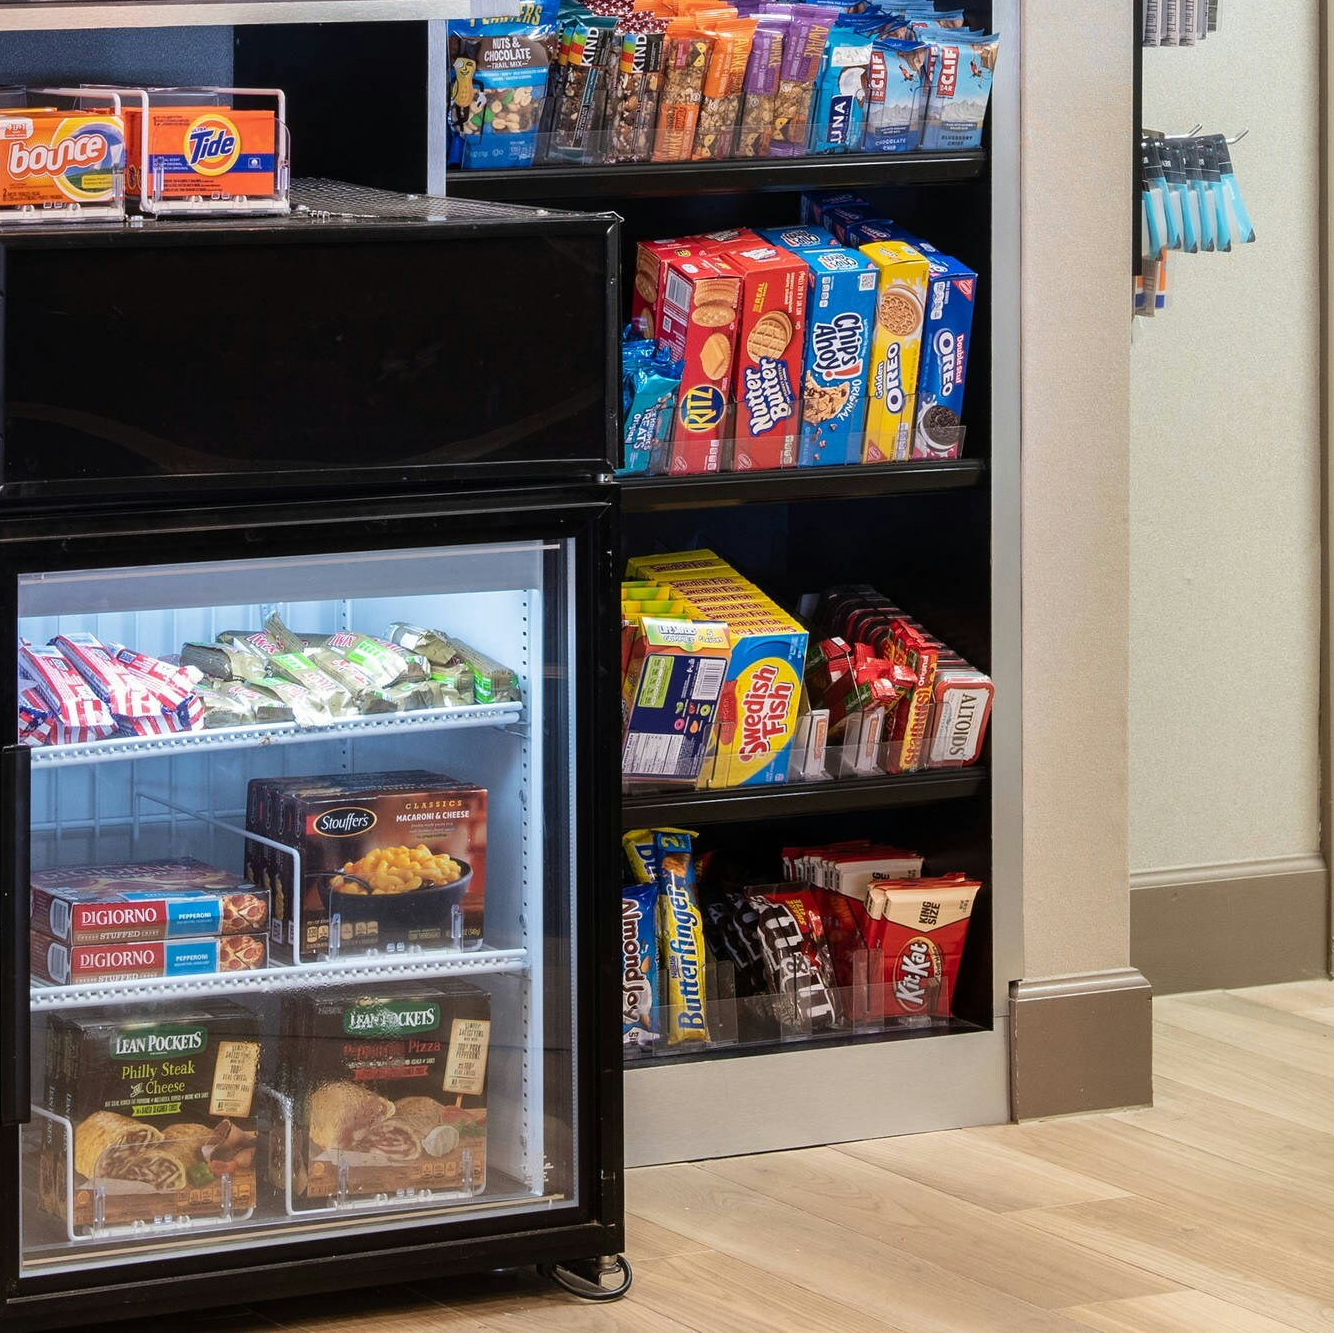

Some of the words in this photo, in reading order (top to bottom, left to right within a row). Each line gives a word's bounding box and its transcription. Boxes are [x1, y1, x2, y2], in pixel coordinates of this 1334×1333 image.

[484, 49, 531, 62] CHOCOLATE
[492, 38, 511, 49] NUTS
[512, 38, 521, 47] &
[581, 27, 600, 66] KIND
[633, 33, 647, 73] KIND
[871, 54, 885, 89] CLIF
[942, 49, 956, 83] CLIF
[10, 137, 103, 173] bounce
[189, 130, 235, 165] Tide
[875, 138, 906, 146] CHOCOLATE
[834, 314, 862, 365] Chips
[875, 362, 883, 399] Golden
[886, 343, 903, 413] OREO
[939, 330, 954, 397] OREO
[746, 369, 773, 434] Nutter
[761, 358, 791, 419] Butter
[837, 380, 862, 421] ORIGINAL
[685, 388, 715, 431] RITZ
[738, 664, 779, 763] Swedish
[762, 682, 795, 754] Fish
[950, 694, 977, 756] ALTOIDS
[320, 813, 369, 831] Stouffer's
[396, 812, 434, 823] MACARONI
[442, 811, 469, 819] CHEESE
[405, 800, 463, 810] CLASSICS
[82, 908, 157, 926] DIGIORNO
[919, 902, 929, 925] KING
[928, 902, 941, 925] SIZE
[100, 931, 140, 940] STUFFED
[80, 950, 155, 968] DIGIORNO
[668, 885, 705, 1031] Butterfinger
[116, 1036, 146, 1054] LEAN
[148, 1031, 202, 1051] POCKETS
[408, 1040, 442, 1053] Pizza
[122, 1064, 158, 1080] Philly
[161, 1060, 195, 1076] Steak
[145, 1079, 186, 1094] Cheese
